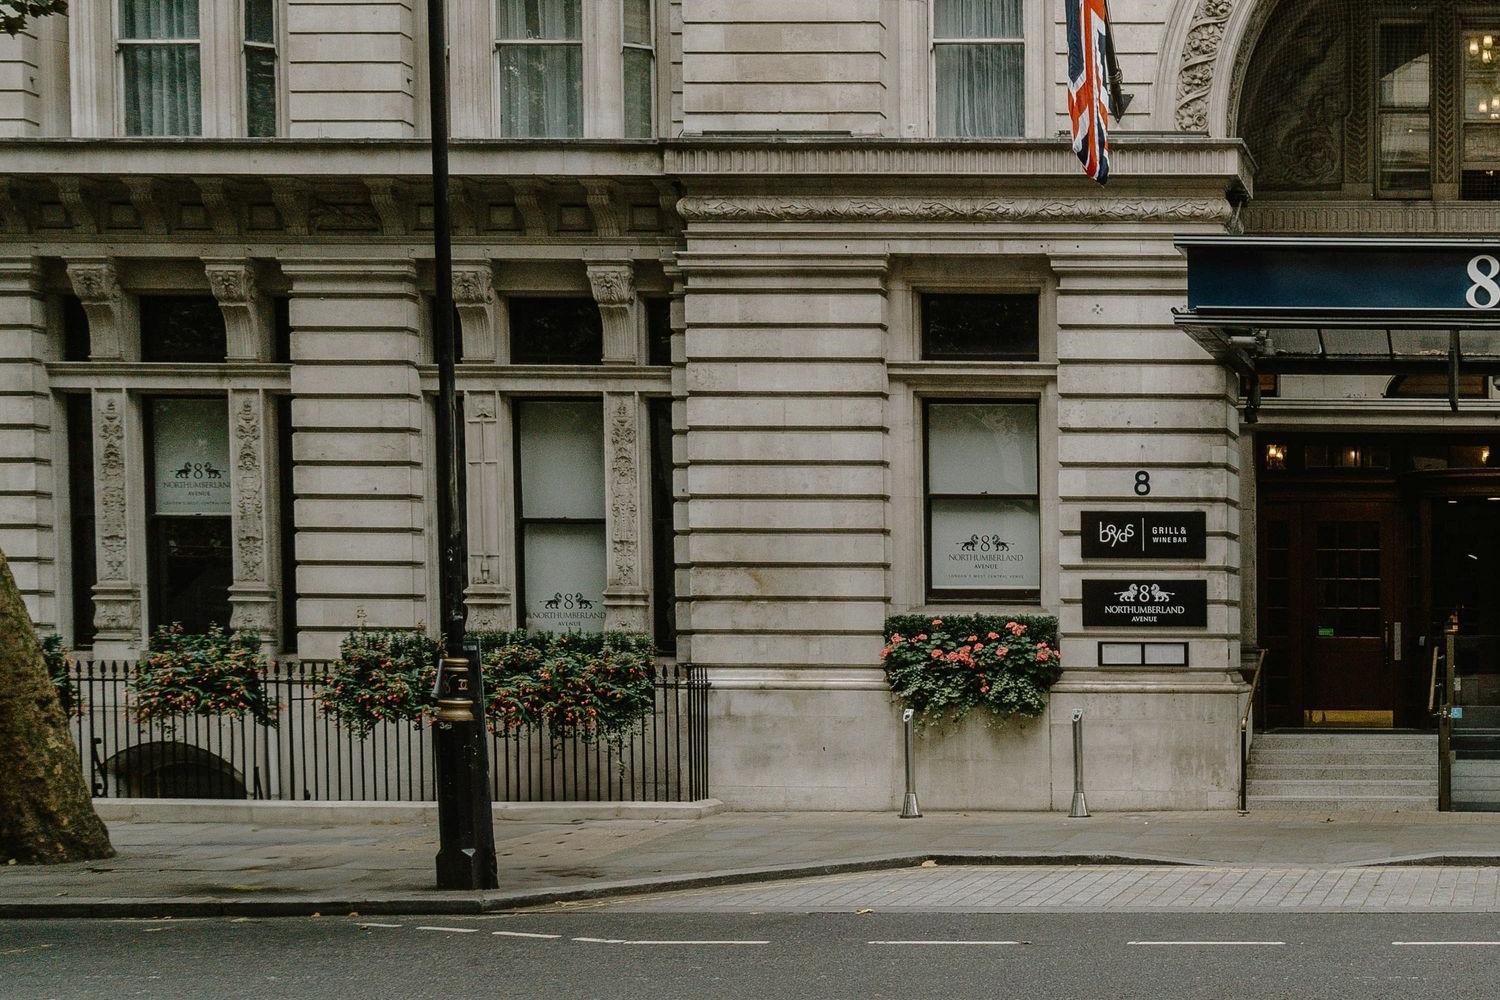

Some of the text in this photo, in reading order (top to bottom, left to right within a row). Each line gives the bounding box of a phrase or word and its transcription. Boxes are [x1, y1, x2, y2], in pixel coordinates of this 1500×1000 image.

[1466, 254, 1500, 308] 8
[194, 463, 203, 479] 8
[163, 481, 231, 489] NORTHUMBERLAN
[1134, 470, 1150, 495] 8
[980, 535, 990, 552] 8
[948, 553, 1024, 561] NORTHUMBERLAND
[564, 593, 574, 610] 8
[1139, 584, 1150, 602] 8
[1104, 605, 1185, 614] NORTHUMBERLAND
